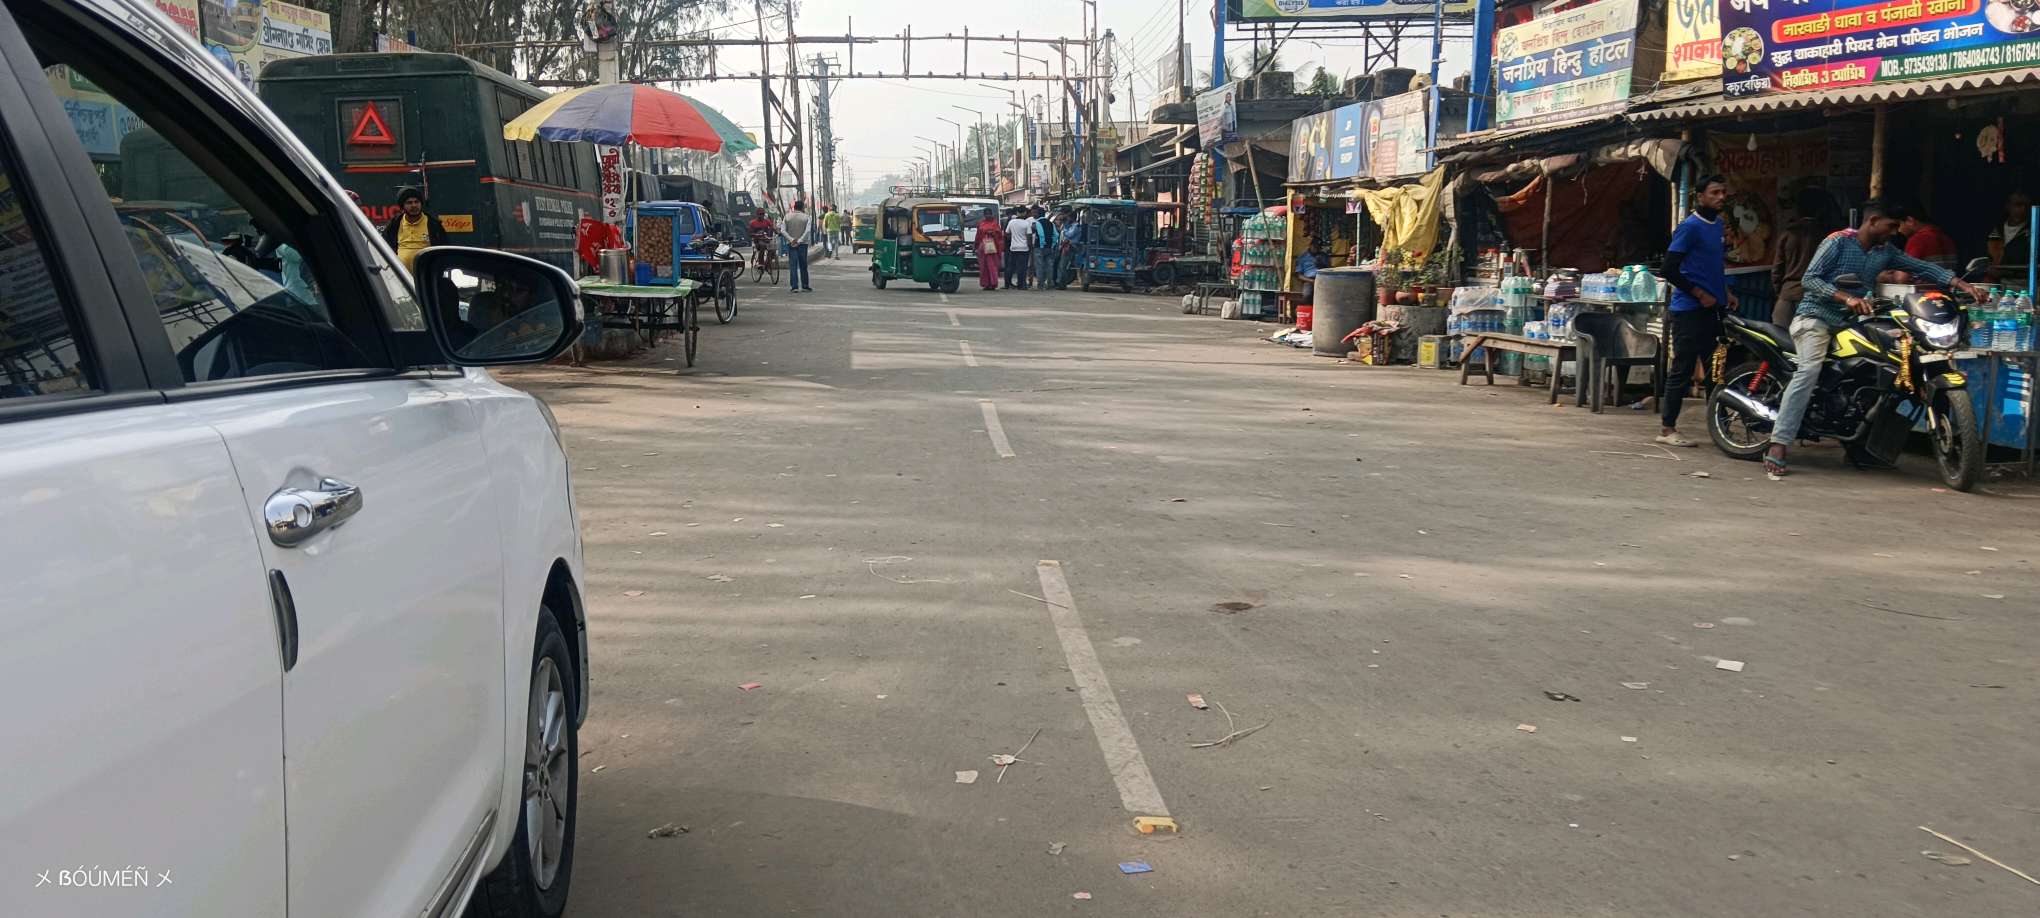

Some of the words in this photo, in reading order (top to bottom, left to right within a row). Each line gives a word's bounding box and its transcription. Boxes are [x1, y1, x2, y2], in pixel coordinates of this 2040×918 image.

[1943, 22, 1985, 41] भोजन
[1502, 56, 1549, 84] जनप्रिय
[1587, 37, 1632, 68] होटल
[1904, 53, 1947, 75] 9735439138
[1953, 46, 2000, 69] 7864084743
